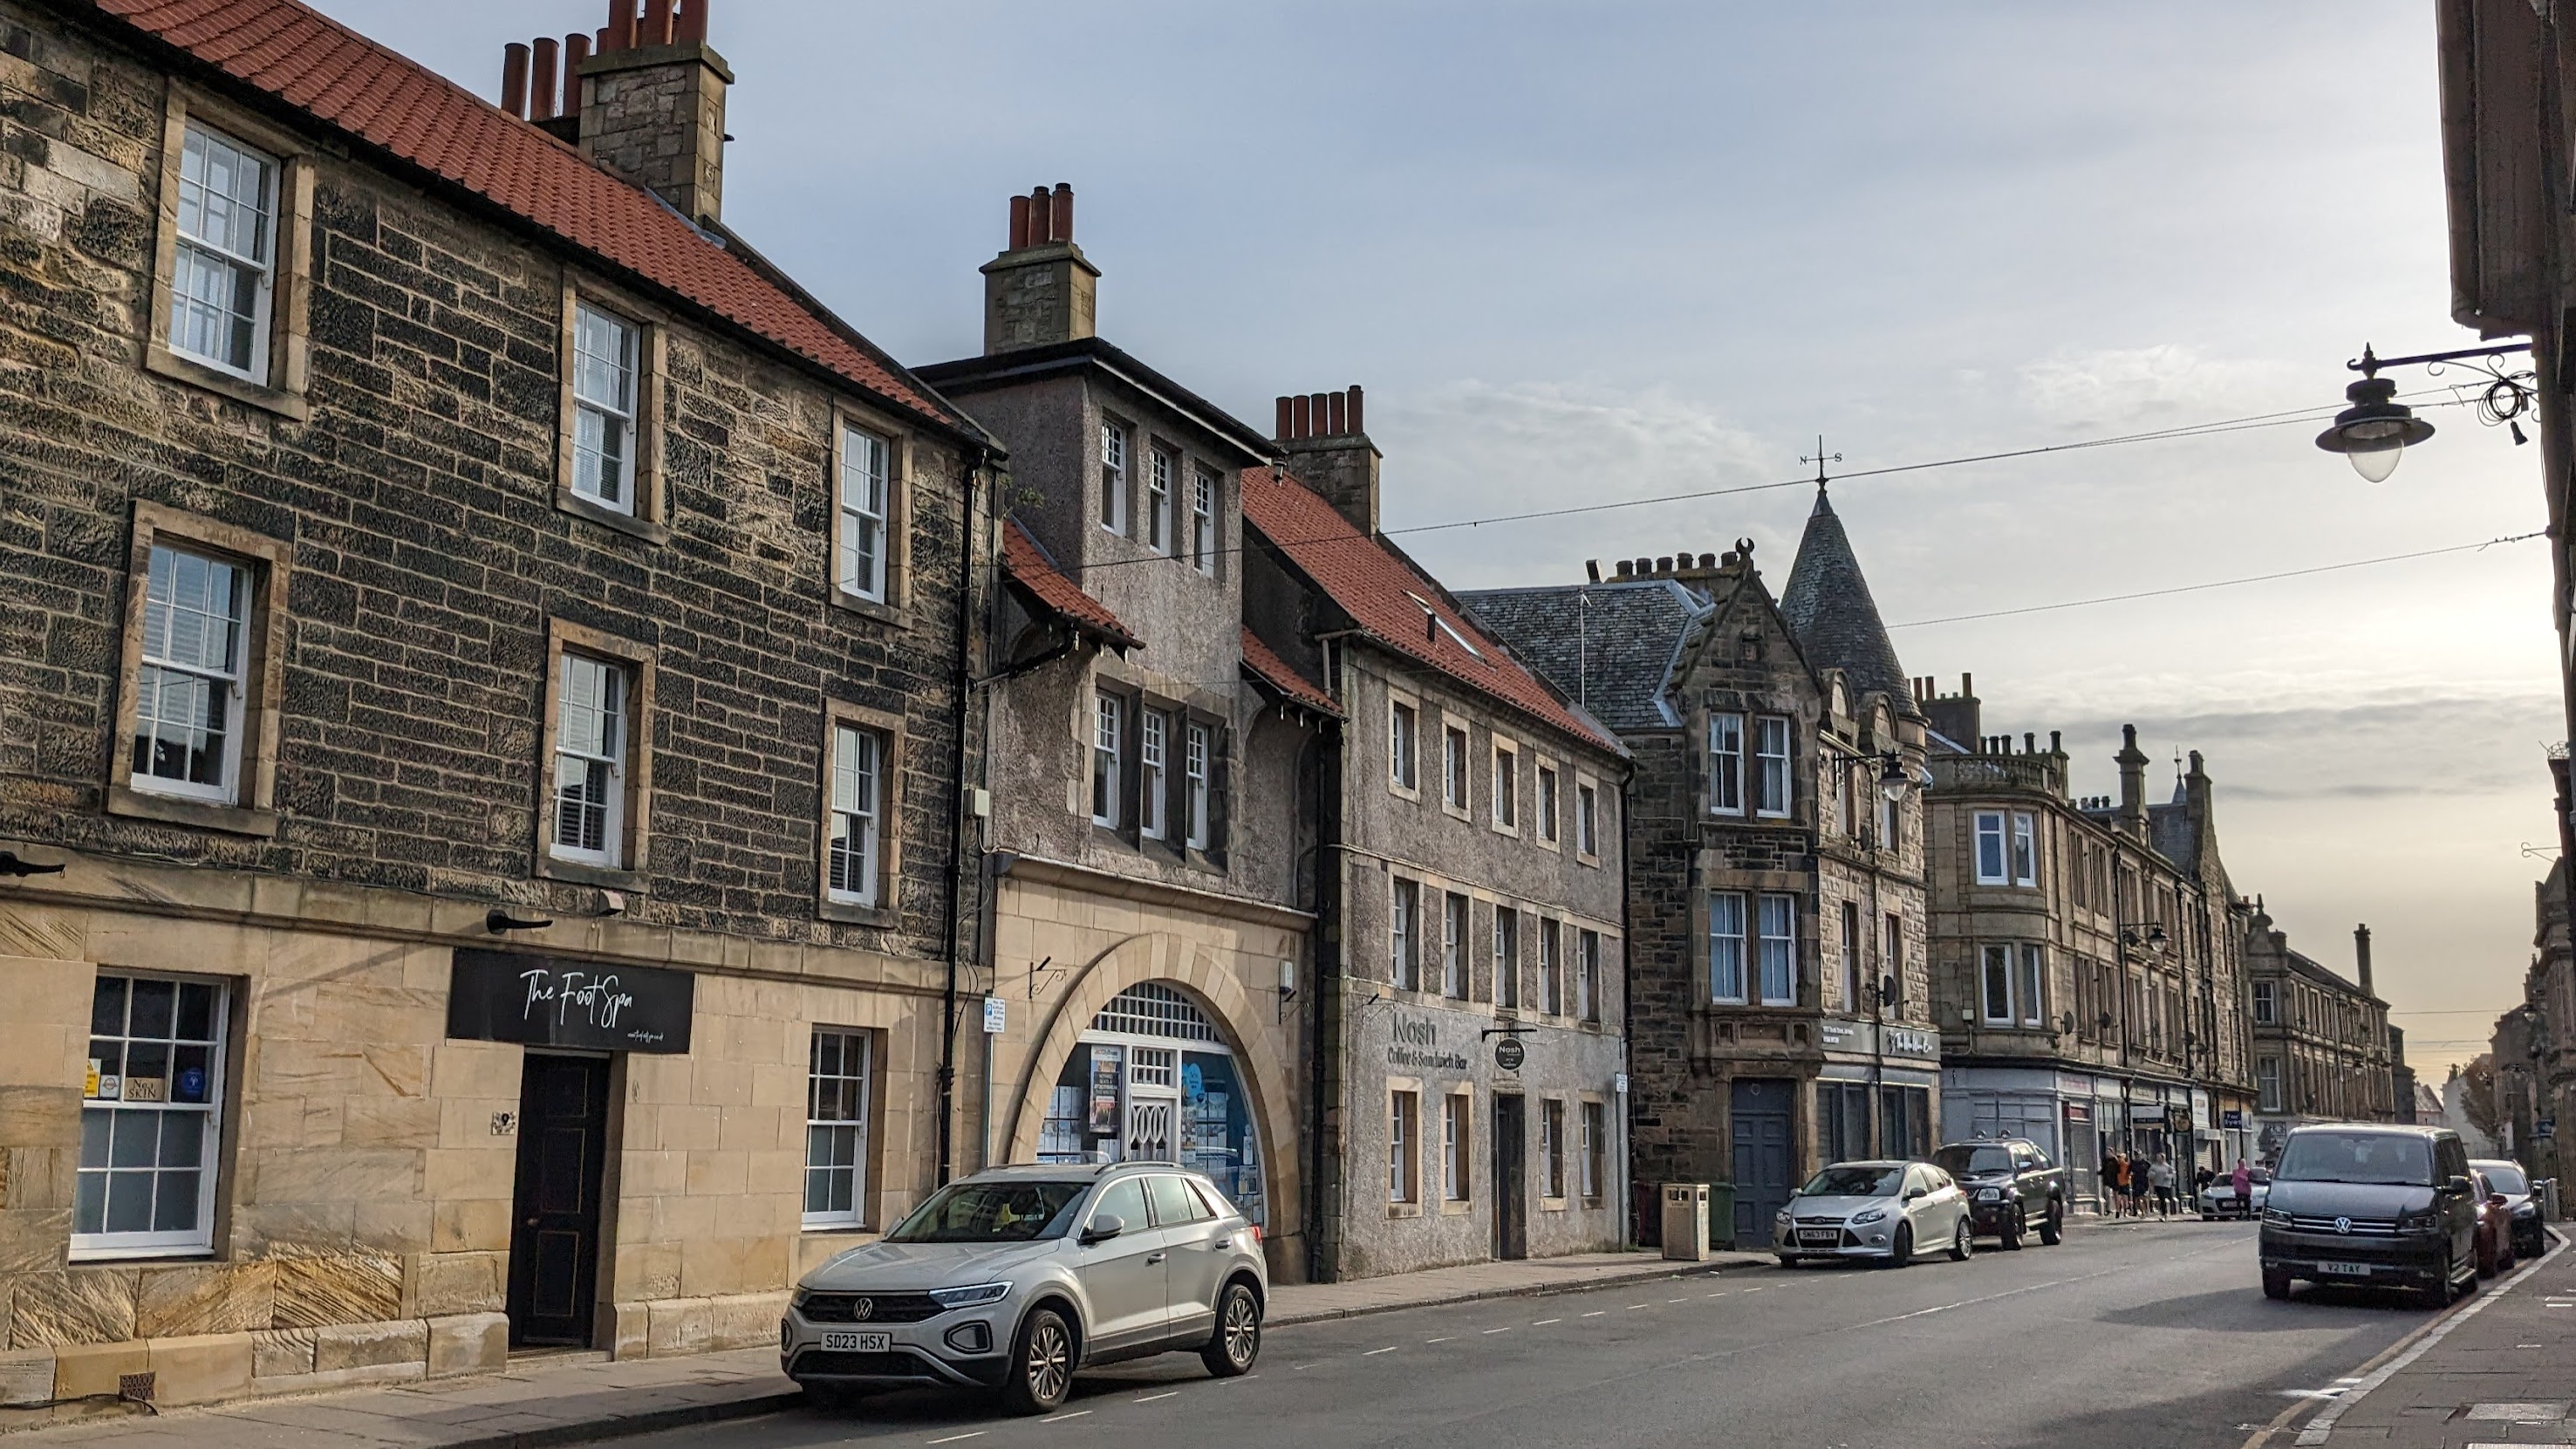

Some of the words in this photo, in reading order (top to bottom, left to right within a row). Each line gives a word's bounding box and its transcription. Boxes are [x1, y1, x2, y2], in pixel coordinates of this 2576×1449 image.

[520, 968, 555, 1021] The
[559, 971, 603, 1026] Foot
[600, 974, 633, 1029] Spa
[1393, 1012, 1437, 1045] Nosh
[1387, 1047, 1411, 1065] Coffee
[1411, 1049, 1418, 1066] &
[1418, 1050, 1454, 1069] Sandwich
[1454, 1054, 1467, 1070] Bar
[128, 1087, 156, 1098] SKIN
[502, 1113, 509, 1126] 9
[2327, 1263, 2340, 1272] V2
[2343, 1264, 2361, 1273] TAY
[826, 1334, 857, 1349] SD23
[860, 1335, 885, 1350] HSX
